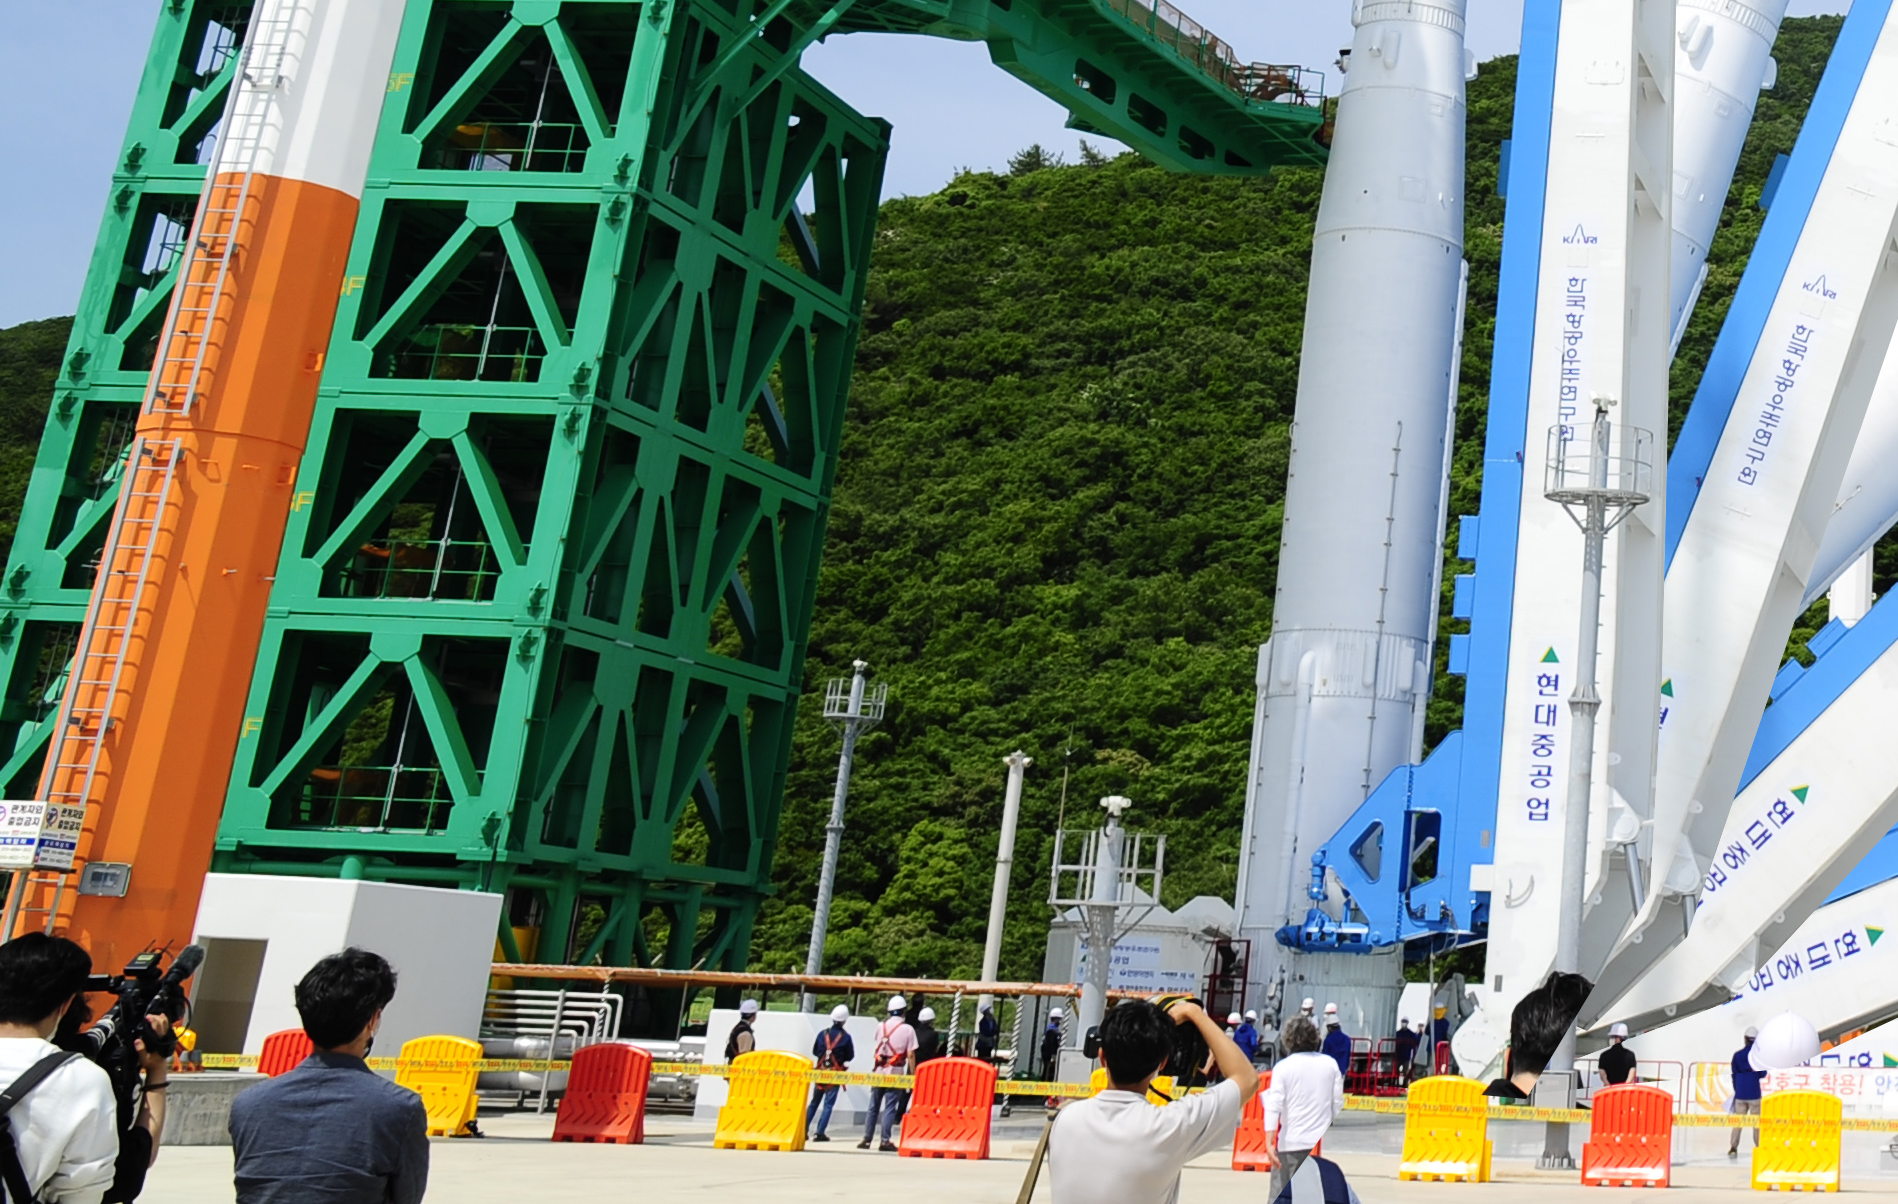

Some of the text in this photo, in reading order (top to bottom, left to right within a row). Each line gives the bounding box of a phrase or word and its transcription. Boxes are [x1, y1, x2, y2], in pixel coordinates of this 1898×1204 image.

[1563, 223, 1598, 245] KARI
[1802, 274, 1837, 300] KARI
[1737, 323, 1815, 486] 한국항공우주연구원
[1526, 673, 1560, 822] 현대중공업
[1697, 798, 1795, 908] 현대중공
[1723, 929, 1861, 1005] 현대중공
